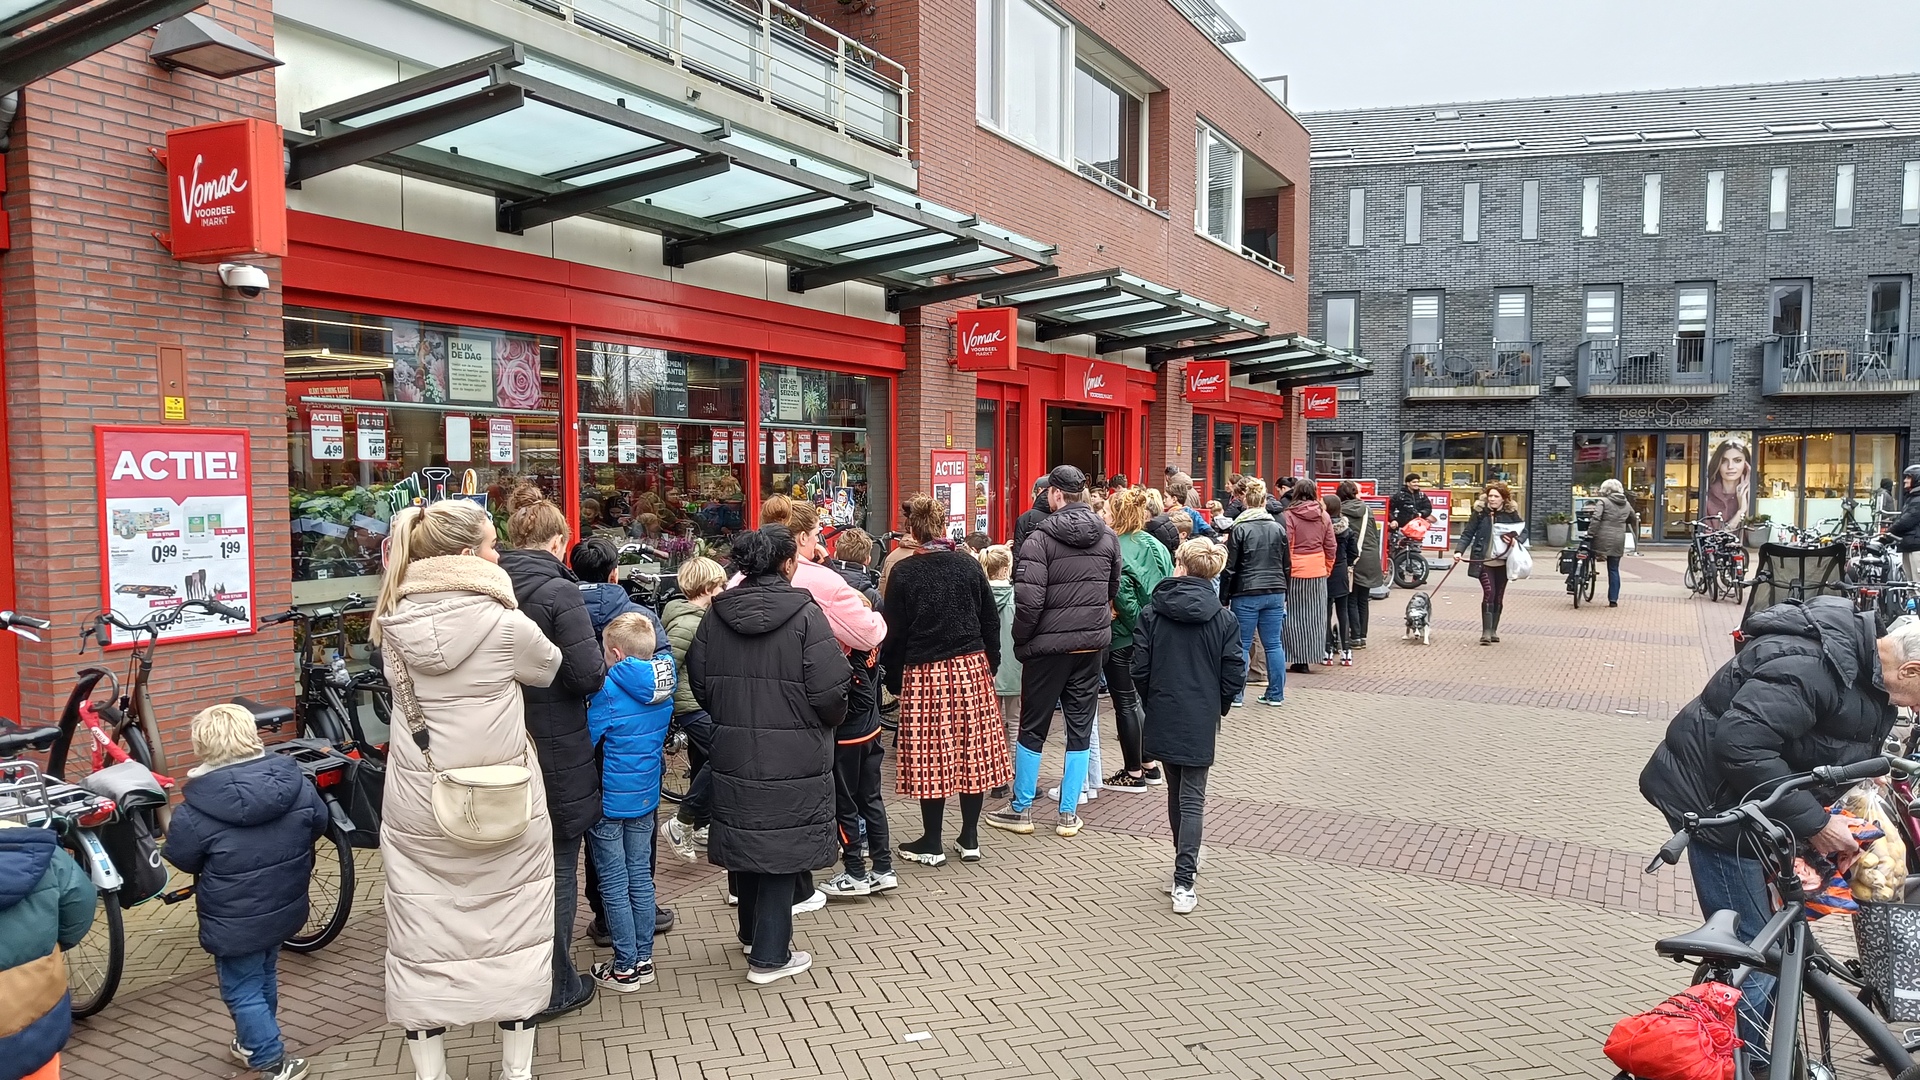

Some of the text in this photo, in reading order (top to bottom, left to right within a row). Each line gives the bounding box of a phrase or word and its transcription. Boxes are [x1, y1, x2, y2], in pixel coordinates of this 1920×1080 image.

[178, 153, 248, 224] Vomar
[195, 205, 236, 218] VOORDEEL
[201, 216, 229, 227] MARKT
[962, 322, 1007, 354] Vomar
[451, 342, 473, 352] PLUK
[451, 351, 482, 361] DE DAG
[1083, 363, 1106, 399] Vomar
[1191, 369, 1225, 392] Vomar
[780, 389, 800, 397] SEIZOEN
[311, 413, 342, 422] ACTIE!
[1619, 406, 1655, 420] peek
[1675, 416, 1713, 426] juwelier
[324, 445, 342, 457] 4.99
[369, 446, 385, 456] 14.99
[592, 449, 605, 457] 1.99
[111, 450, 238, 480] ACTIE!
[935, 461, 964, 476] ACTIE!
[1430, 534, 1443, 545] 1.79
[152, 544, 177, 563] 0.99
[220, 541, 241, 559] 1.99
